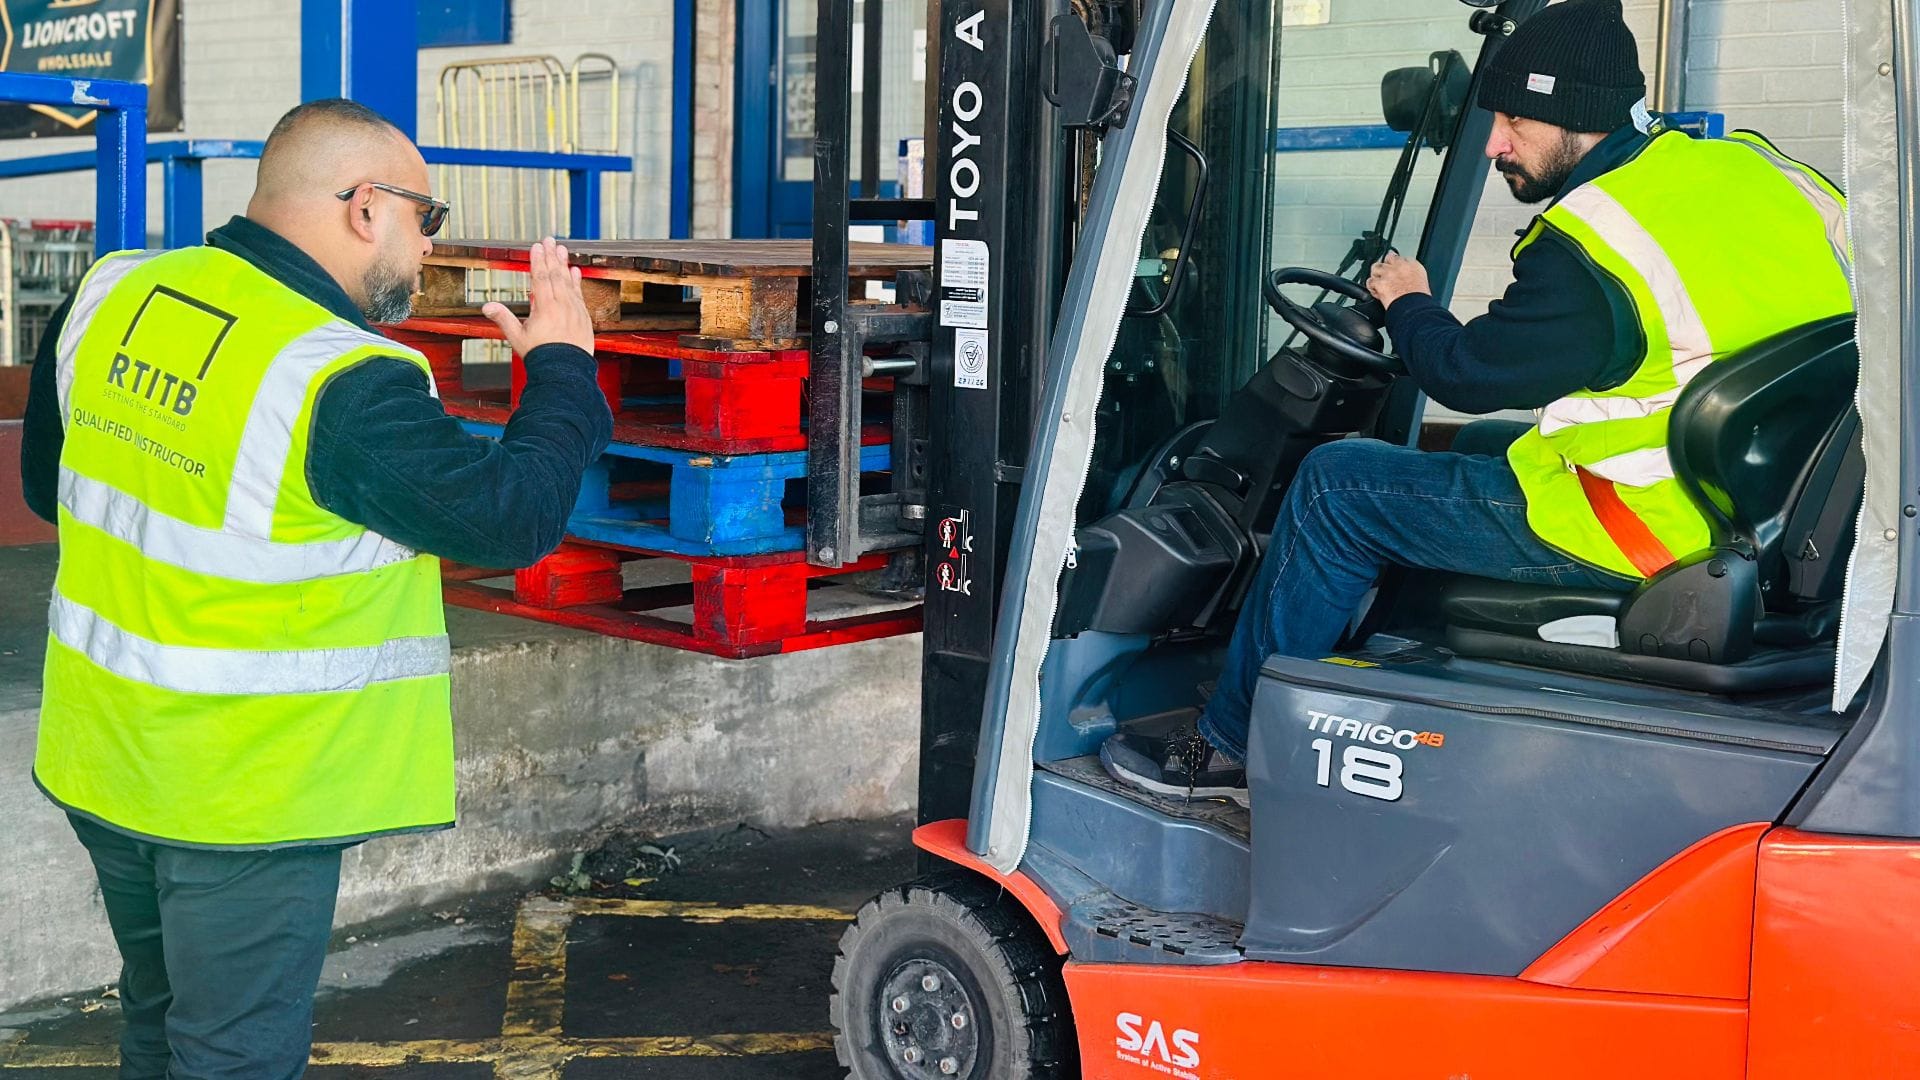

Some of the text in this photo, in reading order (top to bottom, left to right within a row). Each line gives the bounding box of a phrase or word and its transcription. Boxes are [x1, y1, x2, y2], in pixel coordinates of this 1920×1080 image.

[22, 10, 137, 48] LIONCROFT
[37, 51, 113, 71] WHOLESALE
[107, 351, 198, 416] RTITB
[103, 388, 187, 432] SETTING THE STANDARD
[73, 407, 206, 478] QUALIFIED INSTRUCTOR
[1311, 738, 1403, 801] 18
[1116, 1011, 1200, 1069] SAS
[1142, 1059, 1149, 1067] of
[1150, 1061, 1171, 1074] Active
